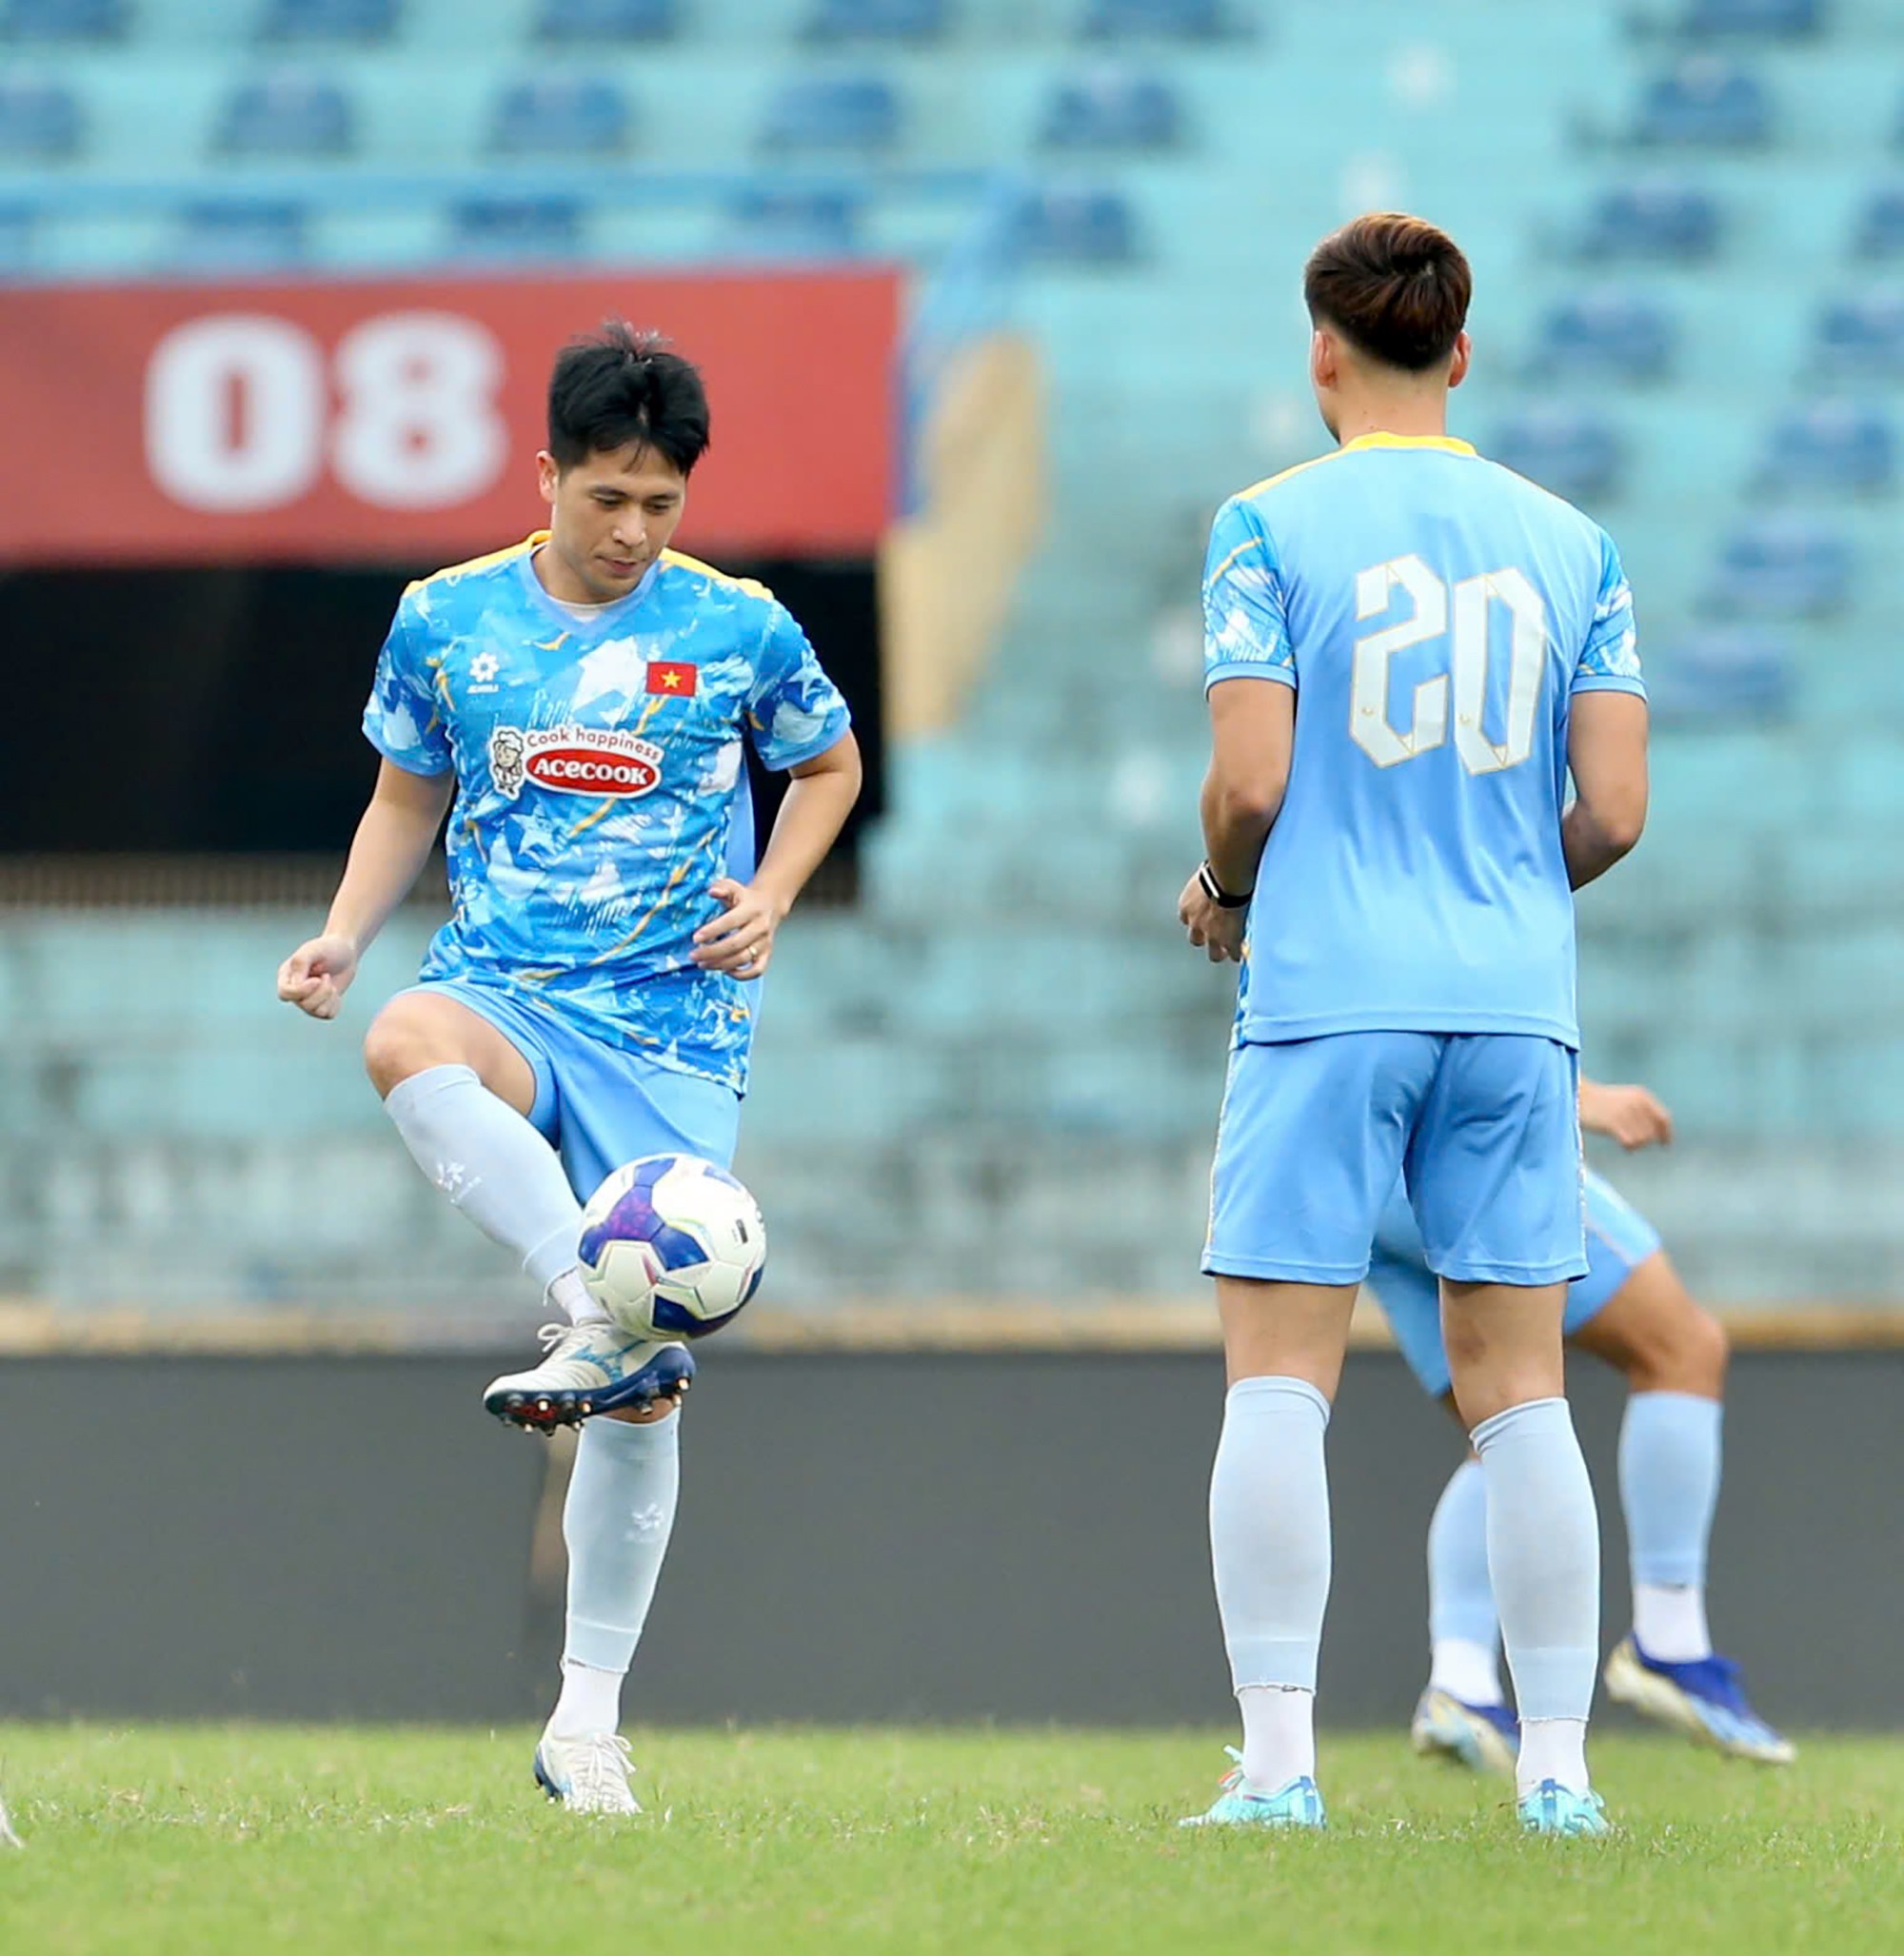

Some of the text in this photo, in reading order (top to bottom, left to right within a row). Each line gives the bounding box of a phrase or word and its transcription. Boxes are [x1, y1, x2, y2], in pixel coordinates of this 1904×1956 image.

[144, 310, 508, 513] 08
[526, 727, 660, 761] Cook happiness
[1349, 552, 1546, 775] 20
